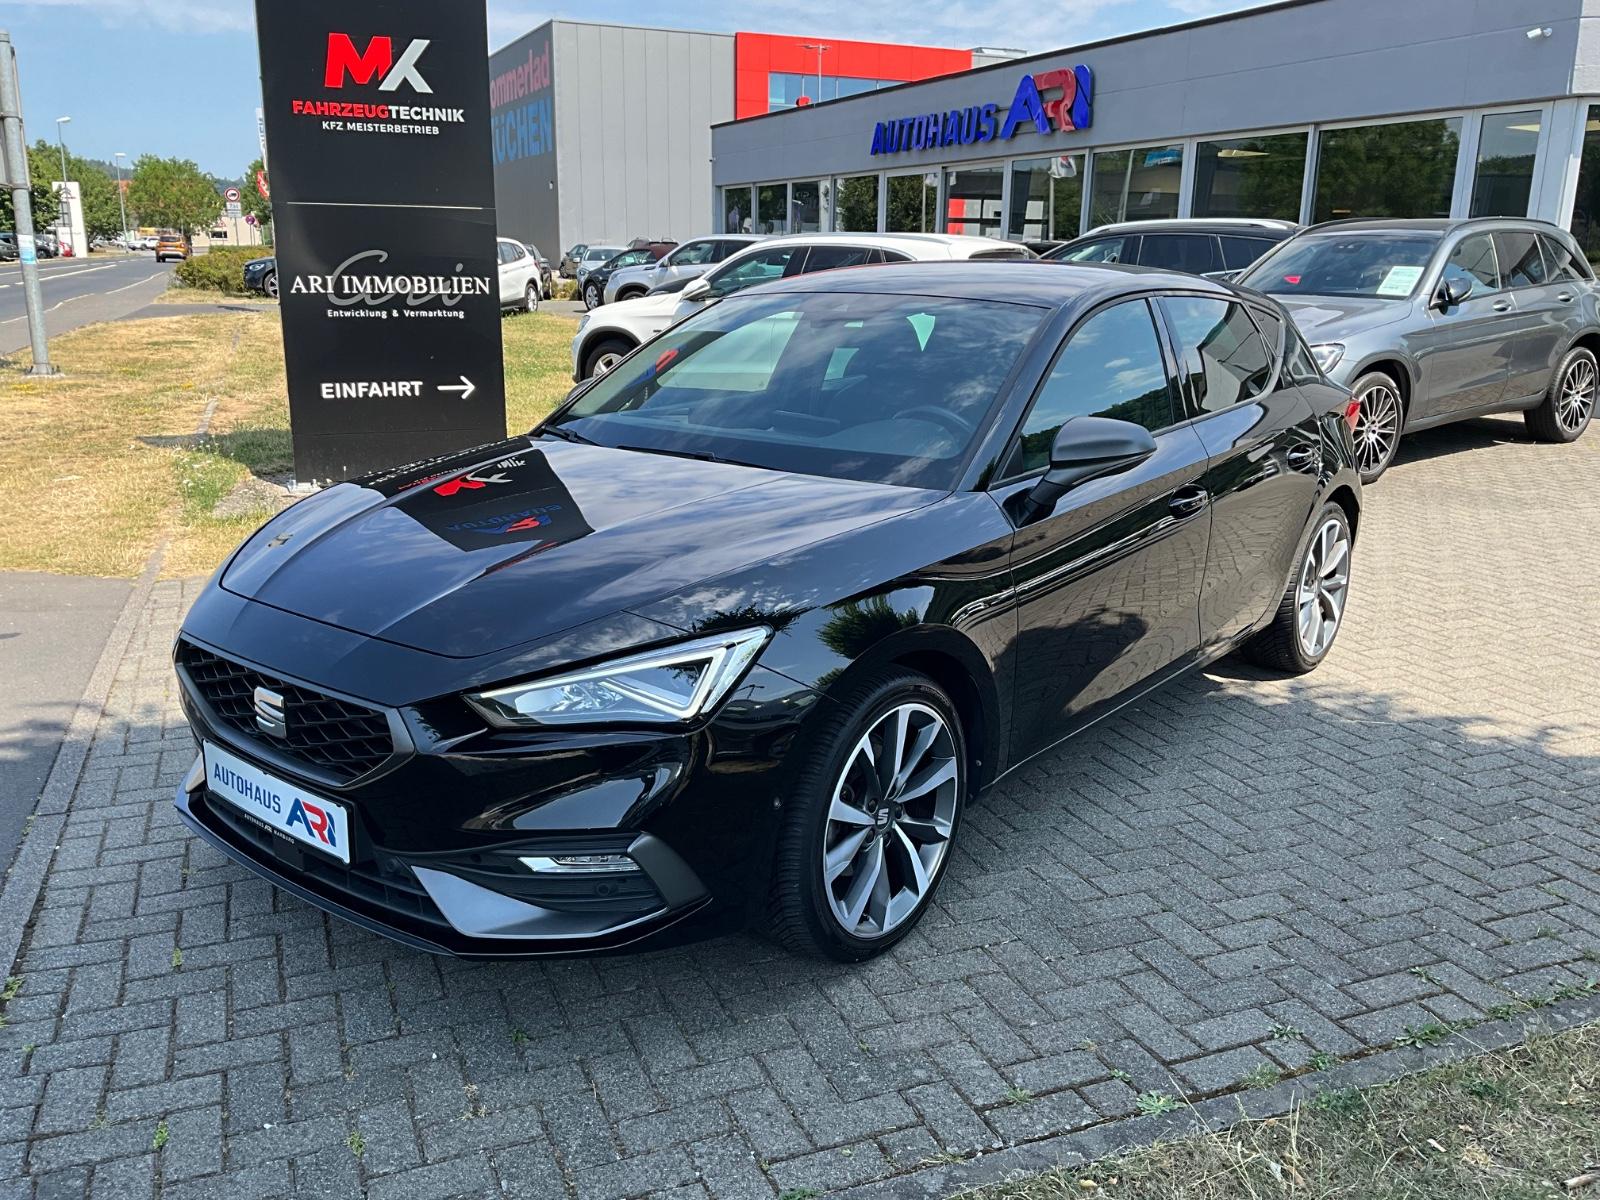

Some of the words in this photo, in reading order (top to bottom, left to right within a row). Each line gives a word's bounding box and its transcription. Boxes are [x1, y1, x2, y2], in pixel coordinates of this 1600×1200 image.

[325, 32, 433, 93] MK
[490, 40, 550, 109] ommerlad
[292, 100, 465, 122] FAHRZEUGTECHNIK
[322, 121, 343, 130] KFZ
[347, 122, 439, 135] MEISTERBETRIEB
[870, 103, 998, 155] AUTOHAUS
[491, 96, 552, 165] ÜCHEN
[291, 275, 334, 293] ARI
[342, 275, 490, 294] IMMOBILIEN
[327, 309, 387, 319] Entwicklung
[392, 309, 399, 317] &
[404, 309, 464, 319] Vermarktung
[320, 381, 423, 399] EINFAHRT
[214, 762, 281, 814] AUTOHAUS
[285, 797, 336, 847] ARI
